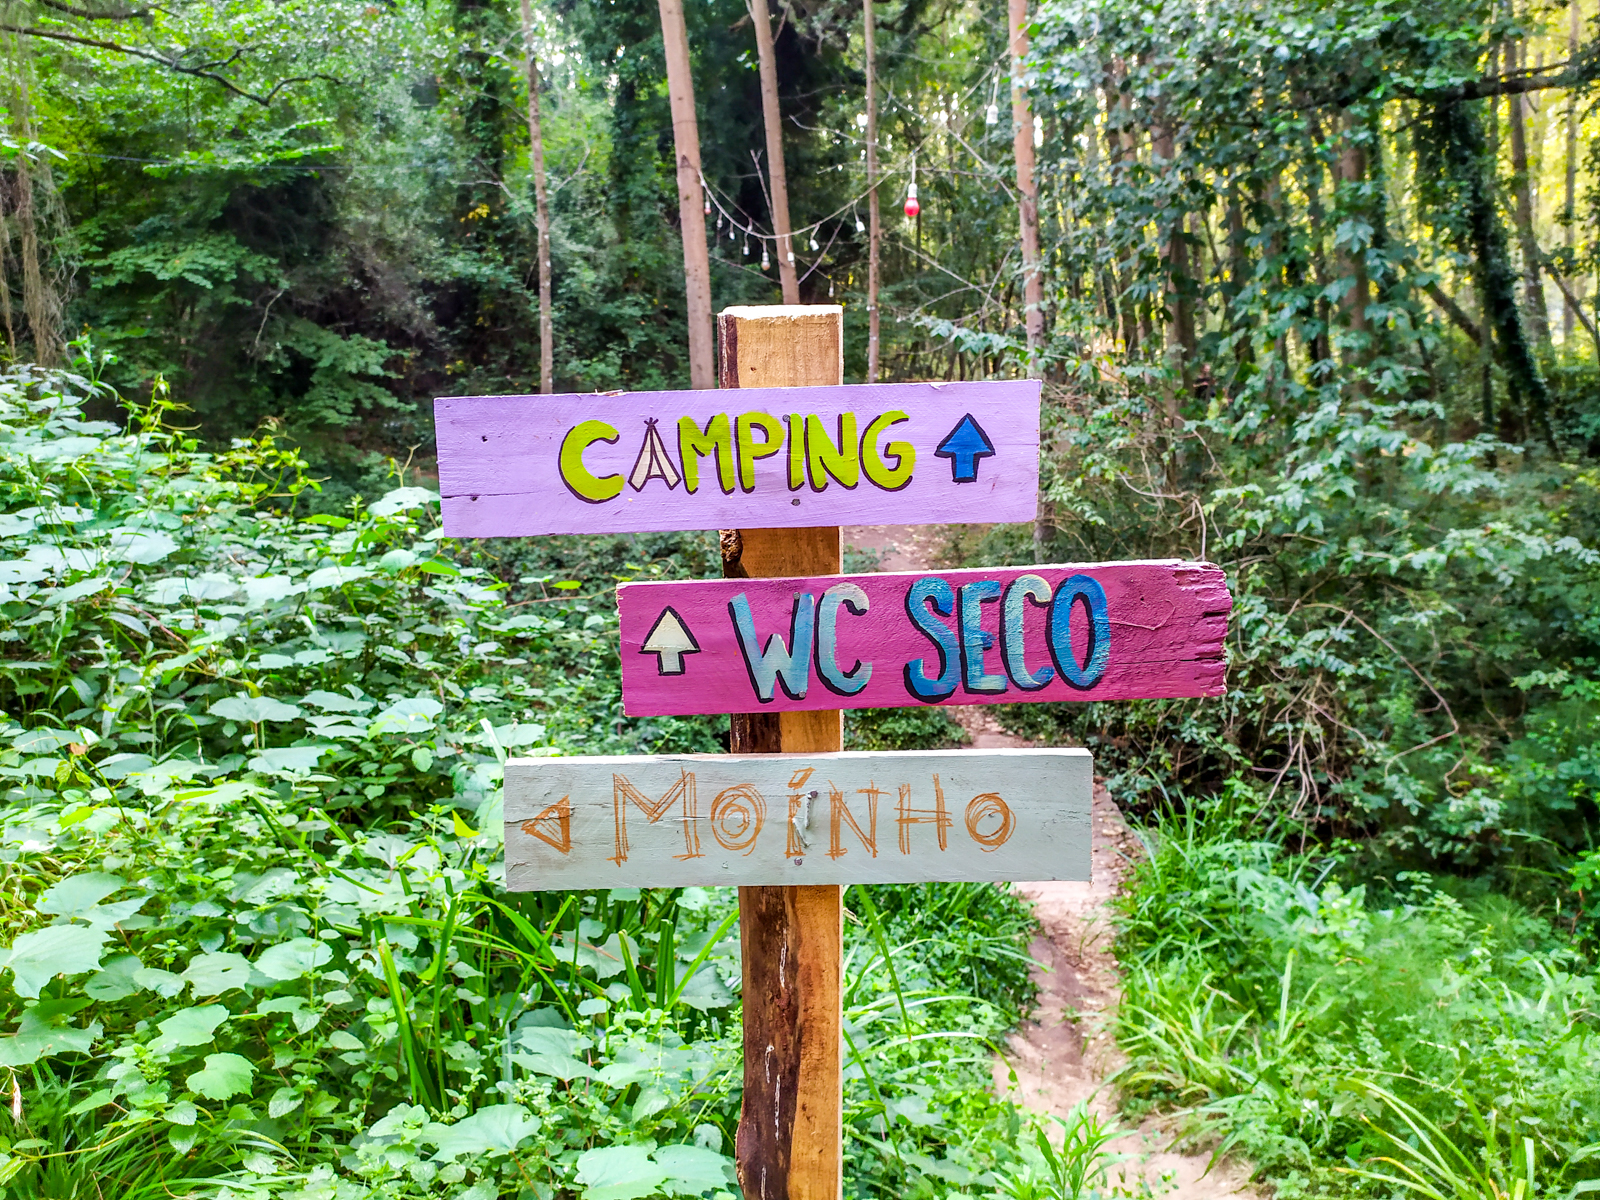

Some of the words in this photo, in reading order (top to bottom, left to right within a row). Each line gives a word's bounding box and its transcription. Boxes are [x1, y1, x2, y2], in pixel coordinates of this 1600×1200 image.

[558, 409, 917, 504] CAMPING
[728, 581, 872, 702] WC
[903, 573, 1111, 703] SECO
